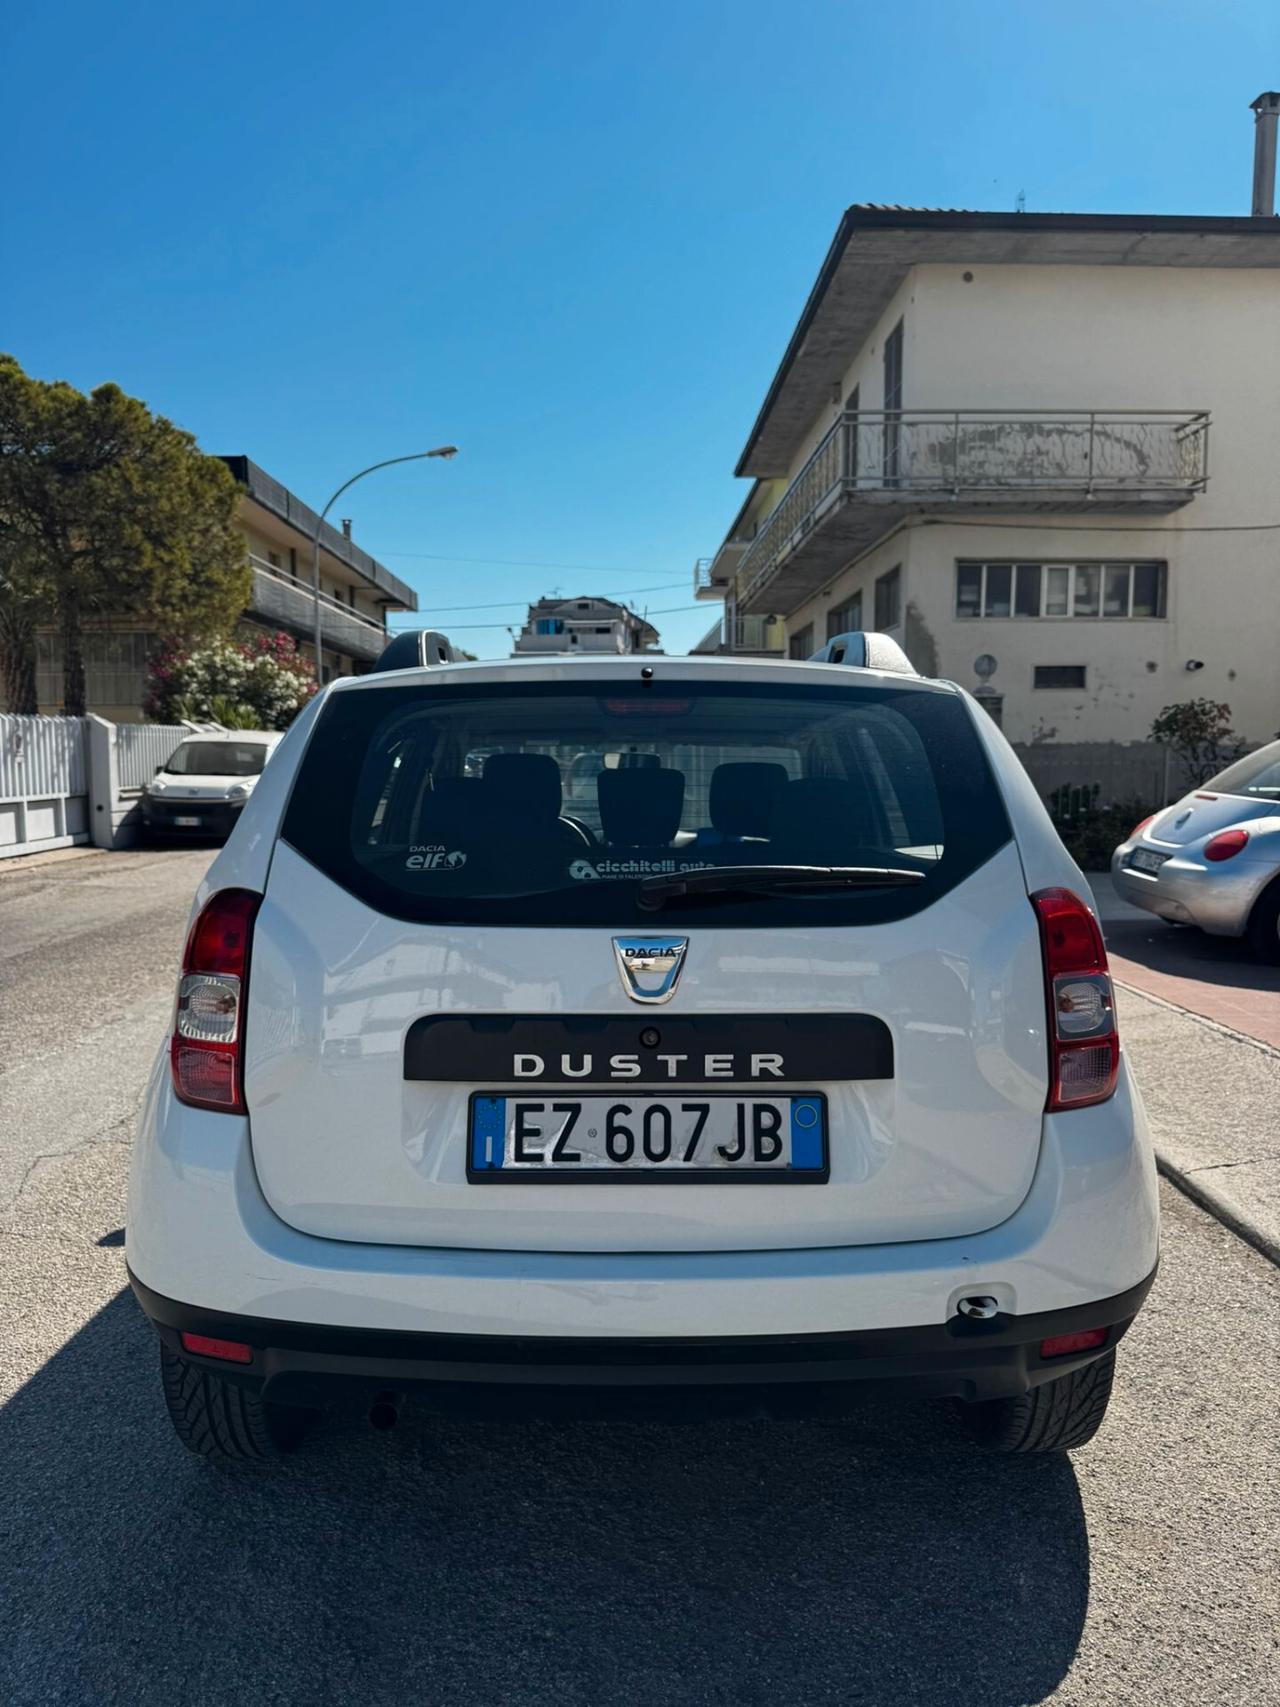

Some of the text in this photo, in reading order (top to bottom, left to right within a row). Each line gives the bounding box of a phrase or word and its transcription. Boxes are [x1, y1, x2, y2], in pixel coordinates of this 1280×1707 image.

[406, 853, 445, 868] elf
[596, 860, 675, 872] cicchitelli
[625, 948, 676, 958] DACIA
[514, 1053, 785, 1077] DUSTER
[515, 1103, 582, 1162] EZ
